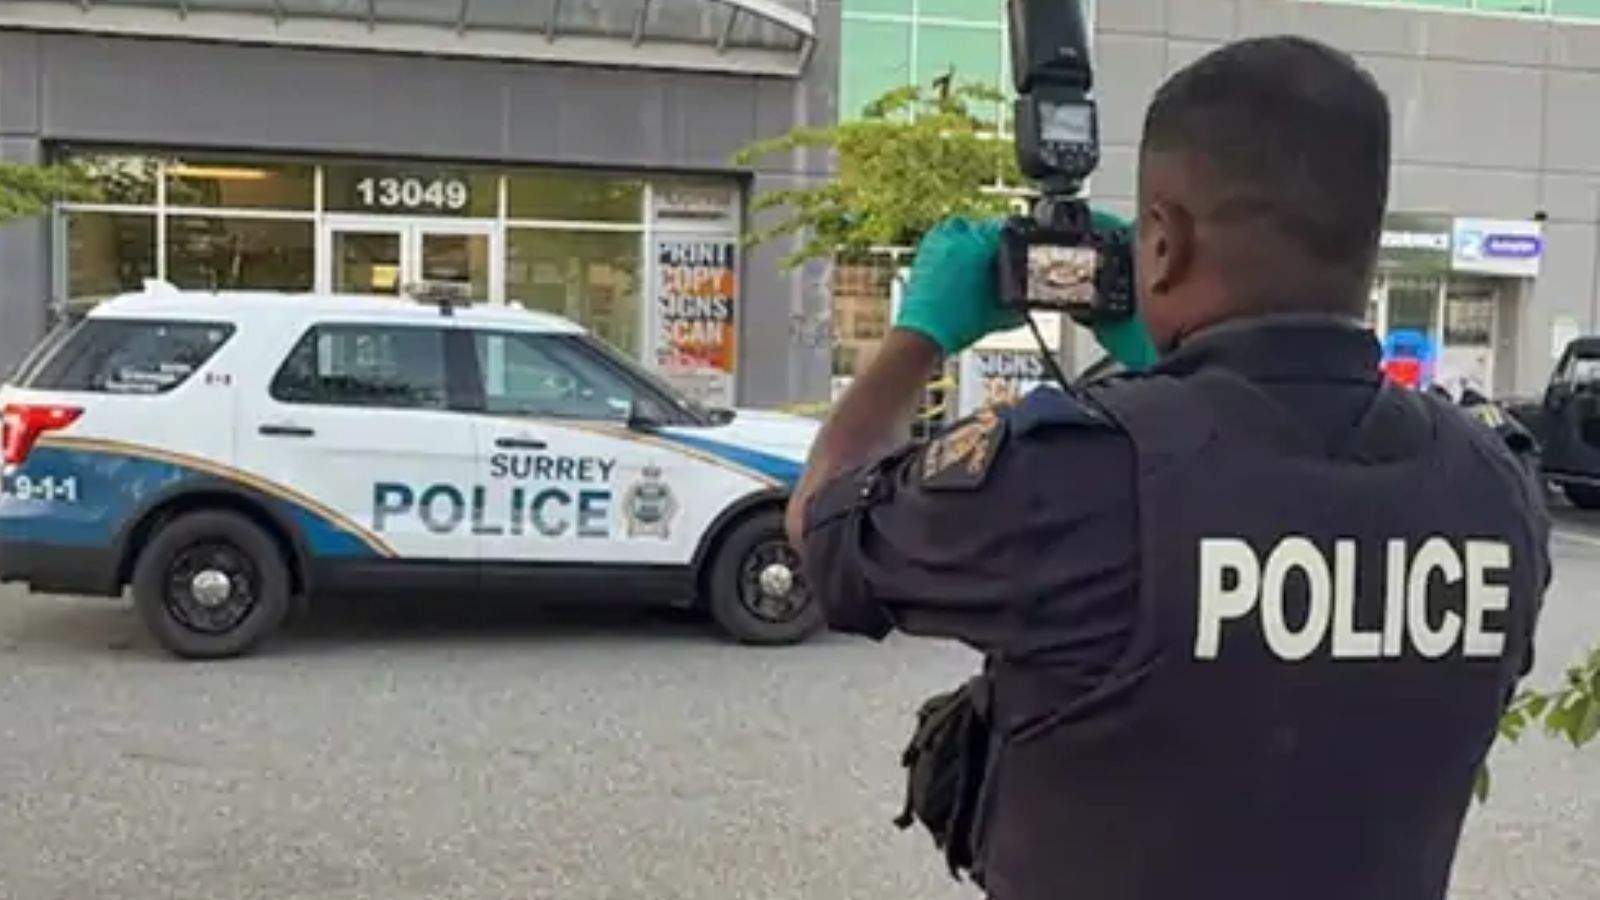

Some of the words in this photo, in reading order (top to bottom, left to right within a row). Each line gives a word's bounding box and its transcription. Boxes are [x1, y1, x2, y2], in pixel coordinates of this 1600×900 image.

[356, 177, 467, 209] 13049
[658, 296, 730, 320] SIGNS
[489, 453, 617, 483] SURREY
[15, 476, 78, 500] 9-1-1
[372, 482, 613, 538] POLICE
[1195, 536, 1511, 660] POLICE
